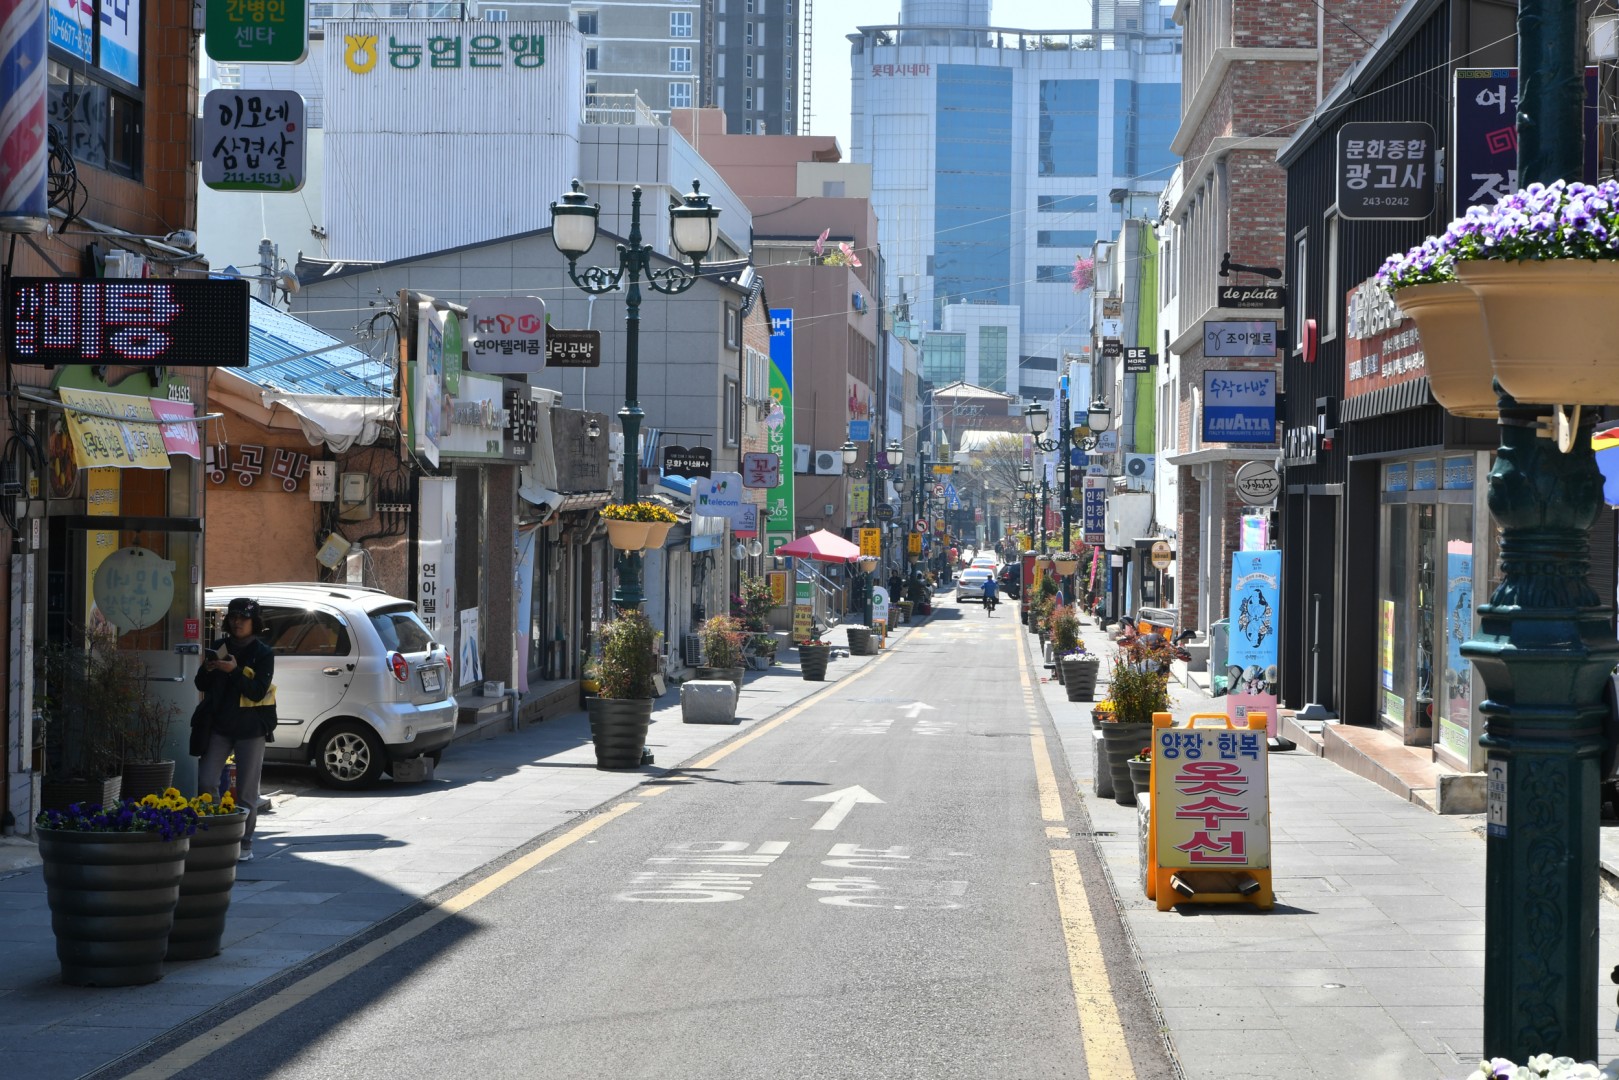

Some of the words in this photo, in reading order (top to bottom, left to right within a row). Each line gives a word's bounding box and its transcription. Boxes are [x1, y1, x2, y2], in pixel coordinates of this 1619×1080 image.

[226, 0, 286, 22] 간병인
[235, 26, 276, 48] 센타
[388, 34, 545, 69] 농협은행
[871, 64, 931, 77] 롯데시네마
[218, 95, 290, 130] 이모네
[212, 132, 294, 170] 삼겹살
[1346, 138, 1427, 160] 문화종합
[223, 171, 281, 184] 211-1513
[1346, 163, 1427, 190] 광고사
[1362, 196, 1410, 206] 243-0242
[1222, 287, 1241, 300] de
[1242, 286, 1279, 302] plata
[473, 314, 495, 334] kt
[473, 339, 541, 355] 연아텔레콤
[1225, 331, 1273, 346] 조이엘로
[1128, 350, 1146, 358] BE
[1210, 378, 1270, 398] 수작다방
[1208, 413, 1271, 431] LAVAZZA
[665, 460, 682, 470] 문화
[683, 460, 710, 471] 인쇄사
[769, 505, 788, 517] 365
[1173, 761, 1249, 865] 옷수선
[1490, 804, 1503, 822] 1-1
